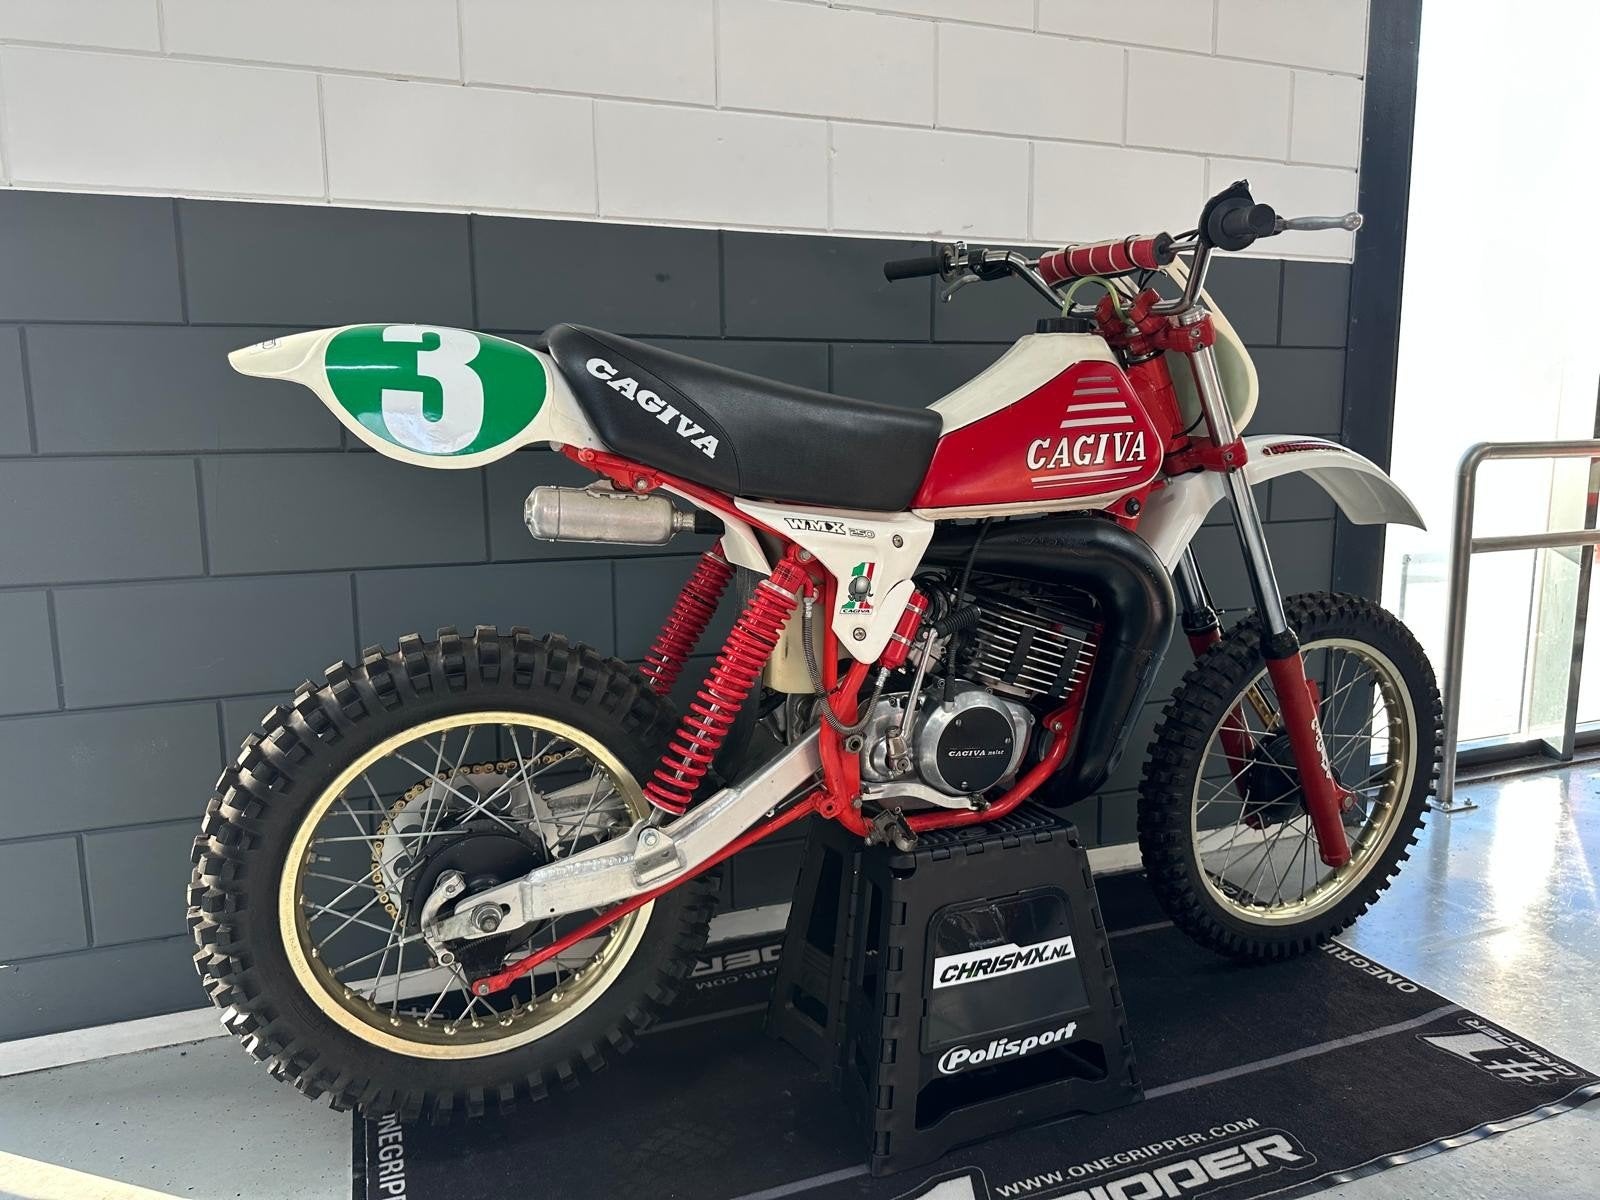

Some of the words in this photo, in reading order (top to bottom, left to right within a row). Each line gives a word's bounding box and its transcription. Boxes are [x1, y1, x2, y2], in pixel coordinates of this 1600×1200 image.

[381, 324, 485, 454] 3
[585, 357, 721, 459] CAGIVA
[1026, 431, 1147, 471] CAGIVA
[784, 517, 846, 535] WMX
[849, 528, 875, 538] 250
[948, 749, 986, 757] CAGIVA
[939, 944, 1072, 984] CHRISMX.NL
[938, 1021, 1077, 1074] Polisport
[378, 1112, 408, 1200] NEGRIP
[995, 1117, 1260, 1197] WWW.ONEGRIPPER.COM
